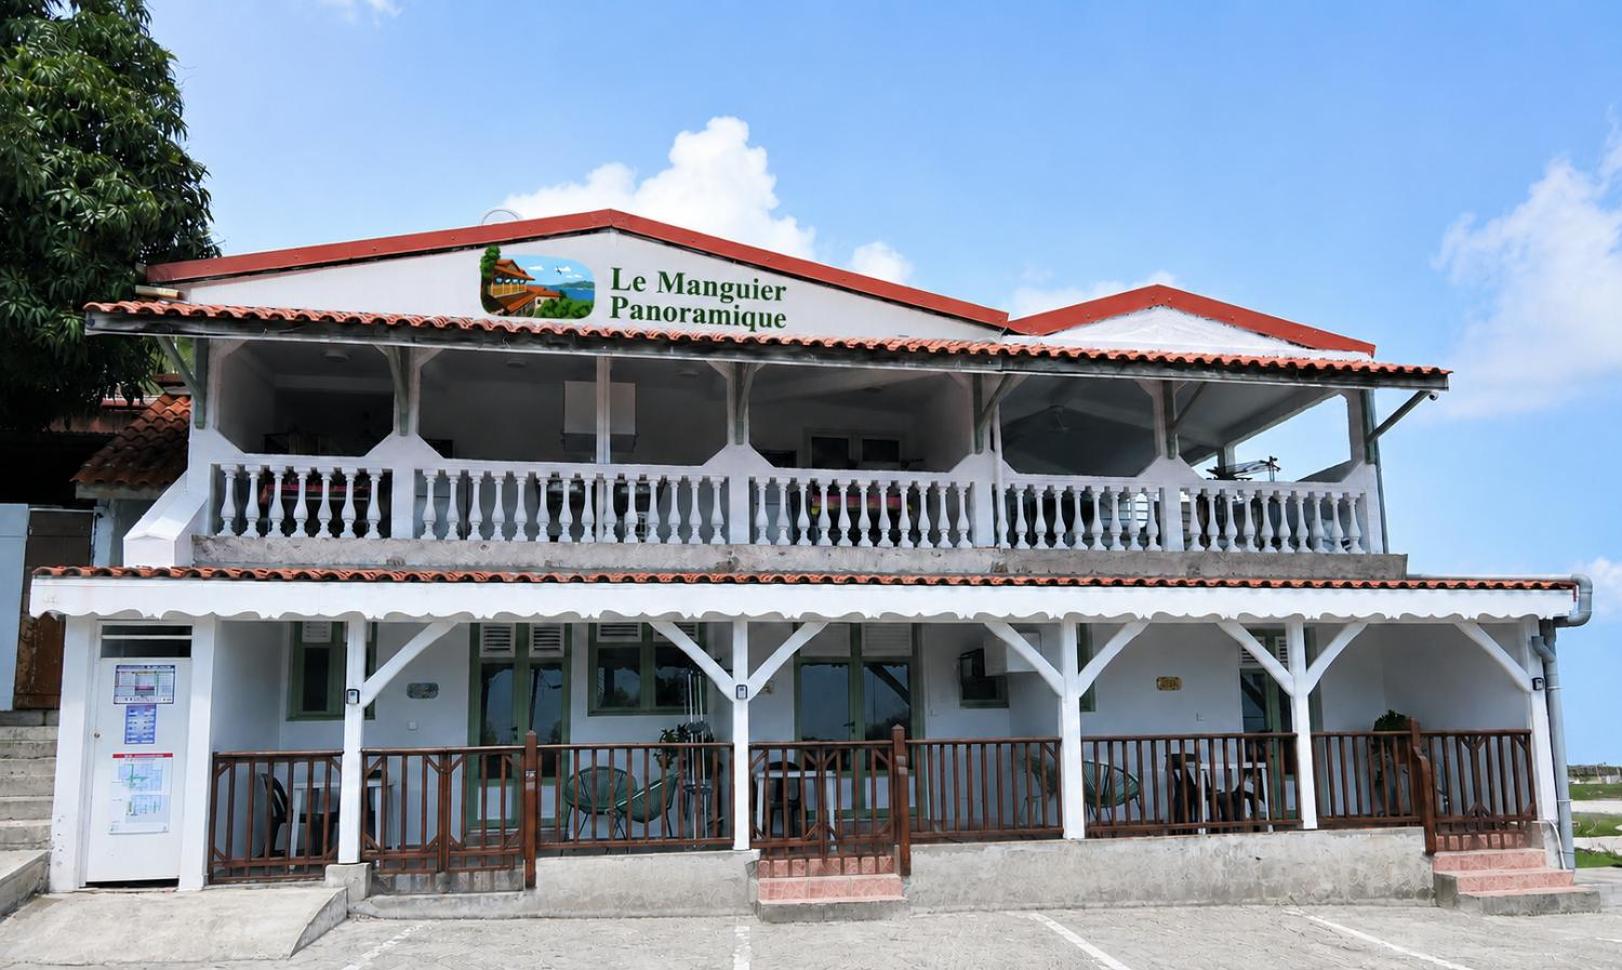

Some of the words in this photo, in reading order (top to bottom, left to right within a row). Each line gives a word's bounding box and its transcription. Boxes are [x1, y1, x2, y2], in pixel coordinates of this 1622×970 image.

[611, 267, 647, 292] Le
[657, 271, 787, 304] Manguier
[610, 295, 787, 333] Panoramique
